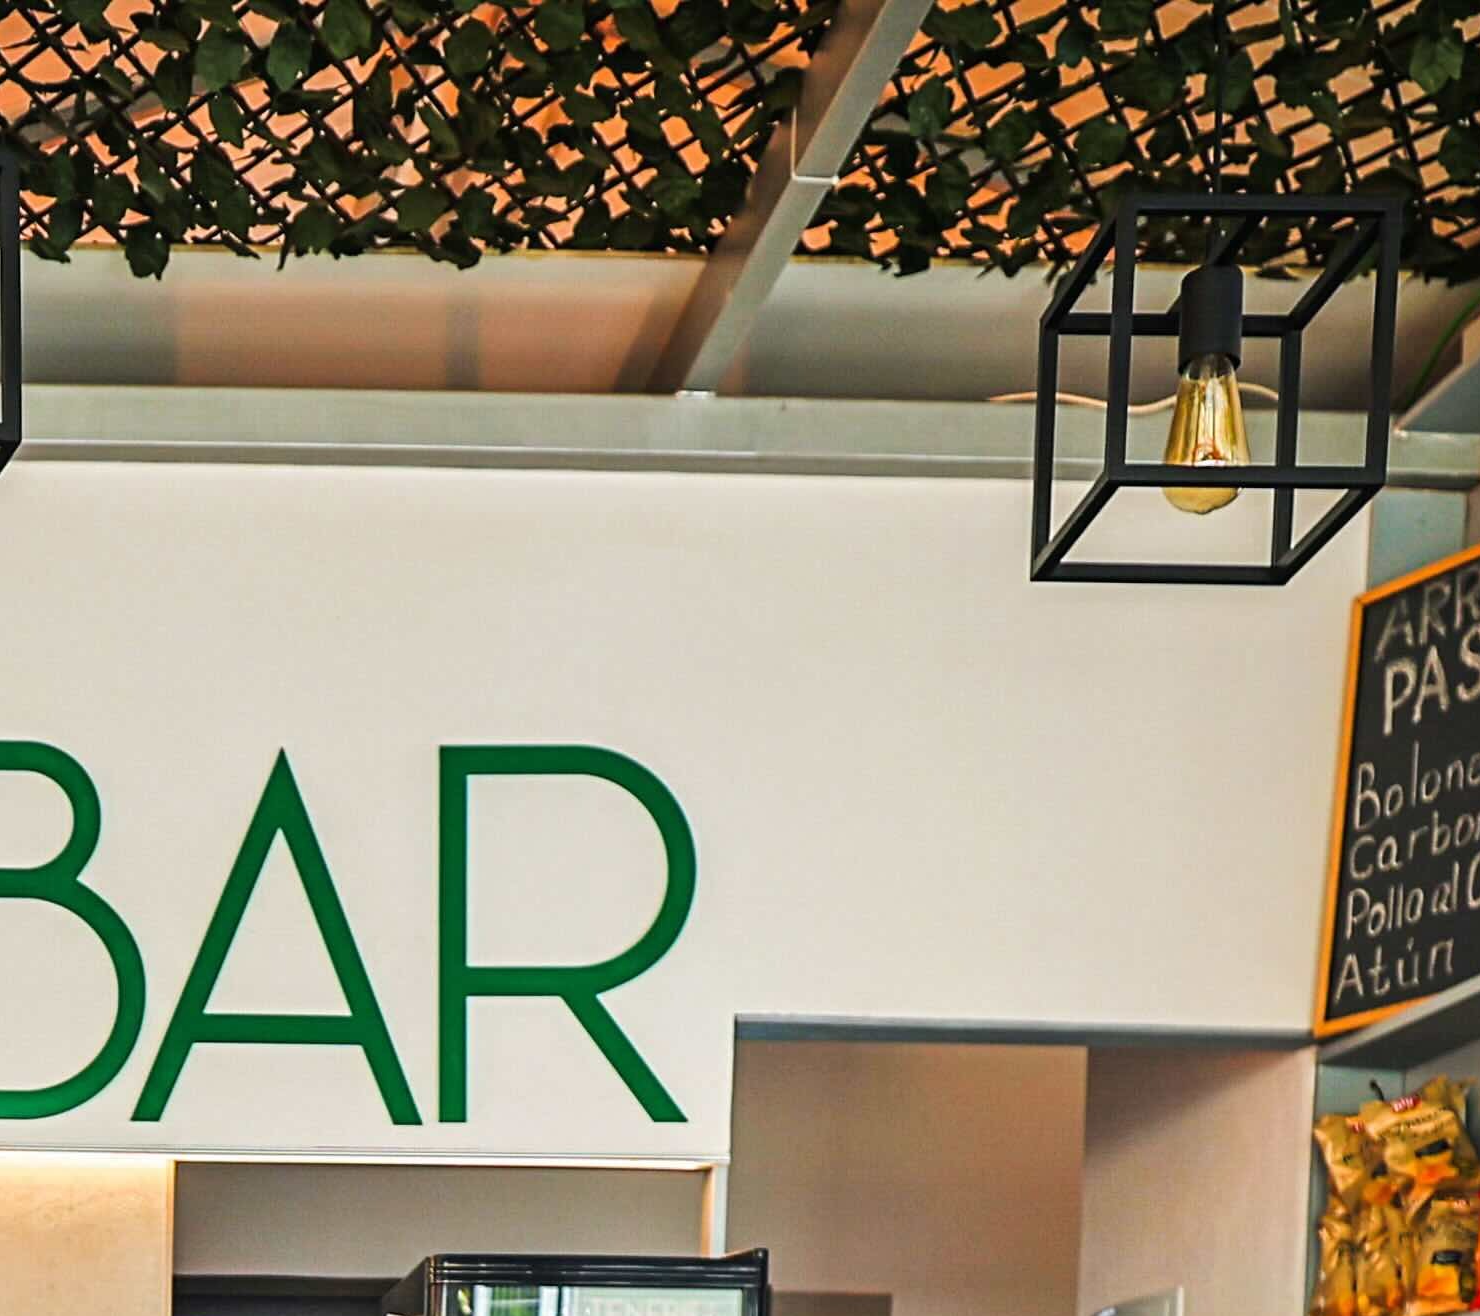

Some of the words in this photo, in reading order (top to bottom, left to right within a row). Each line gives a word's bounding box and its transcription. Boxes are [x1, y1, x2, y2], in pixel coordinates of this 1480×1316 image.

[1346, 887, 1425, 941] Pollo
[1431, 860, 1460, 916] al
[1334, 936, 1455, 1005] Atún
